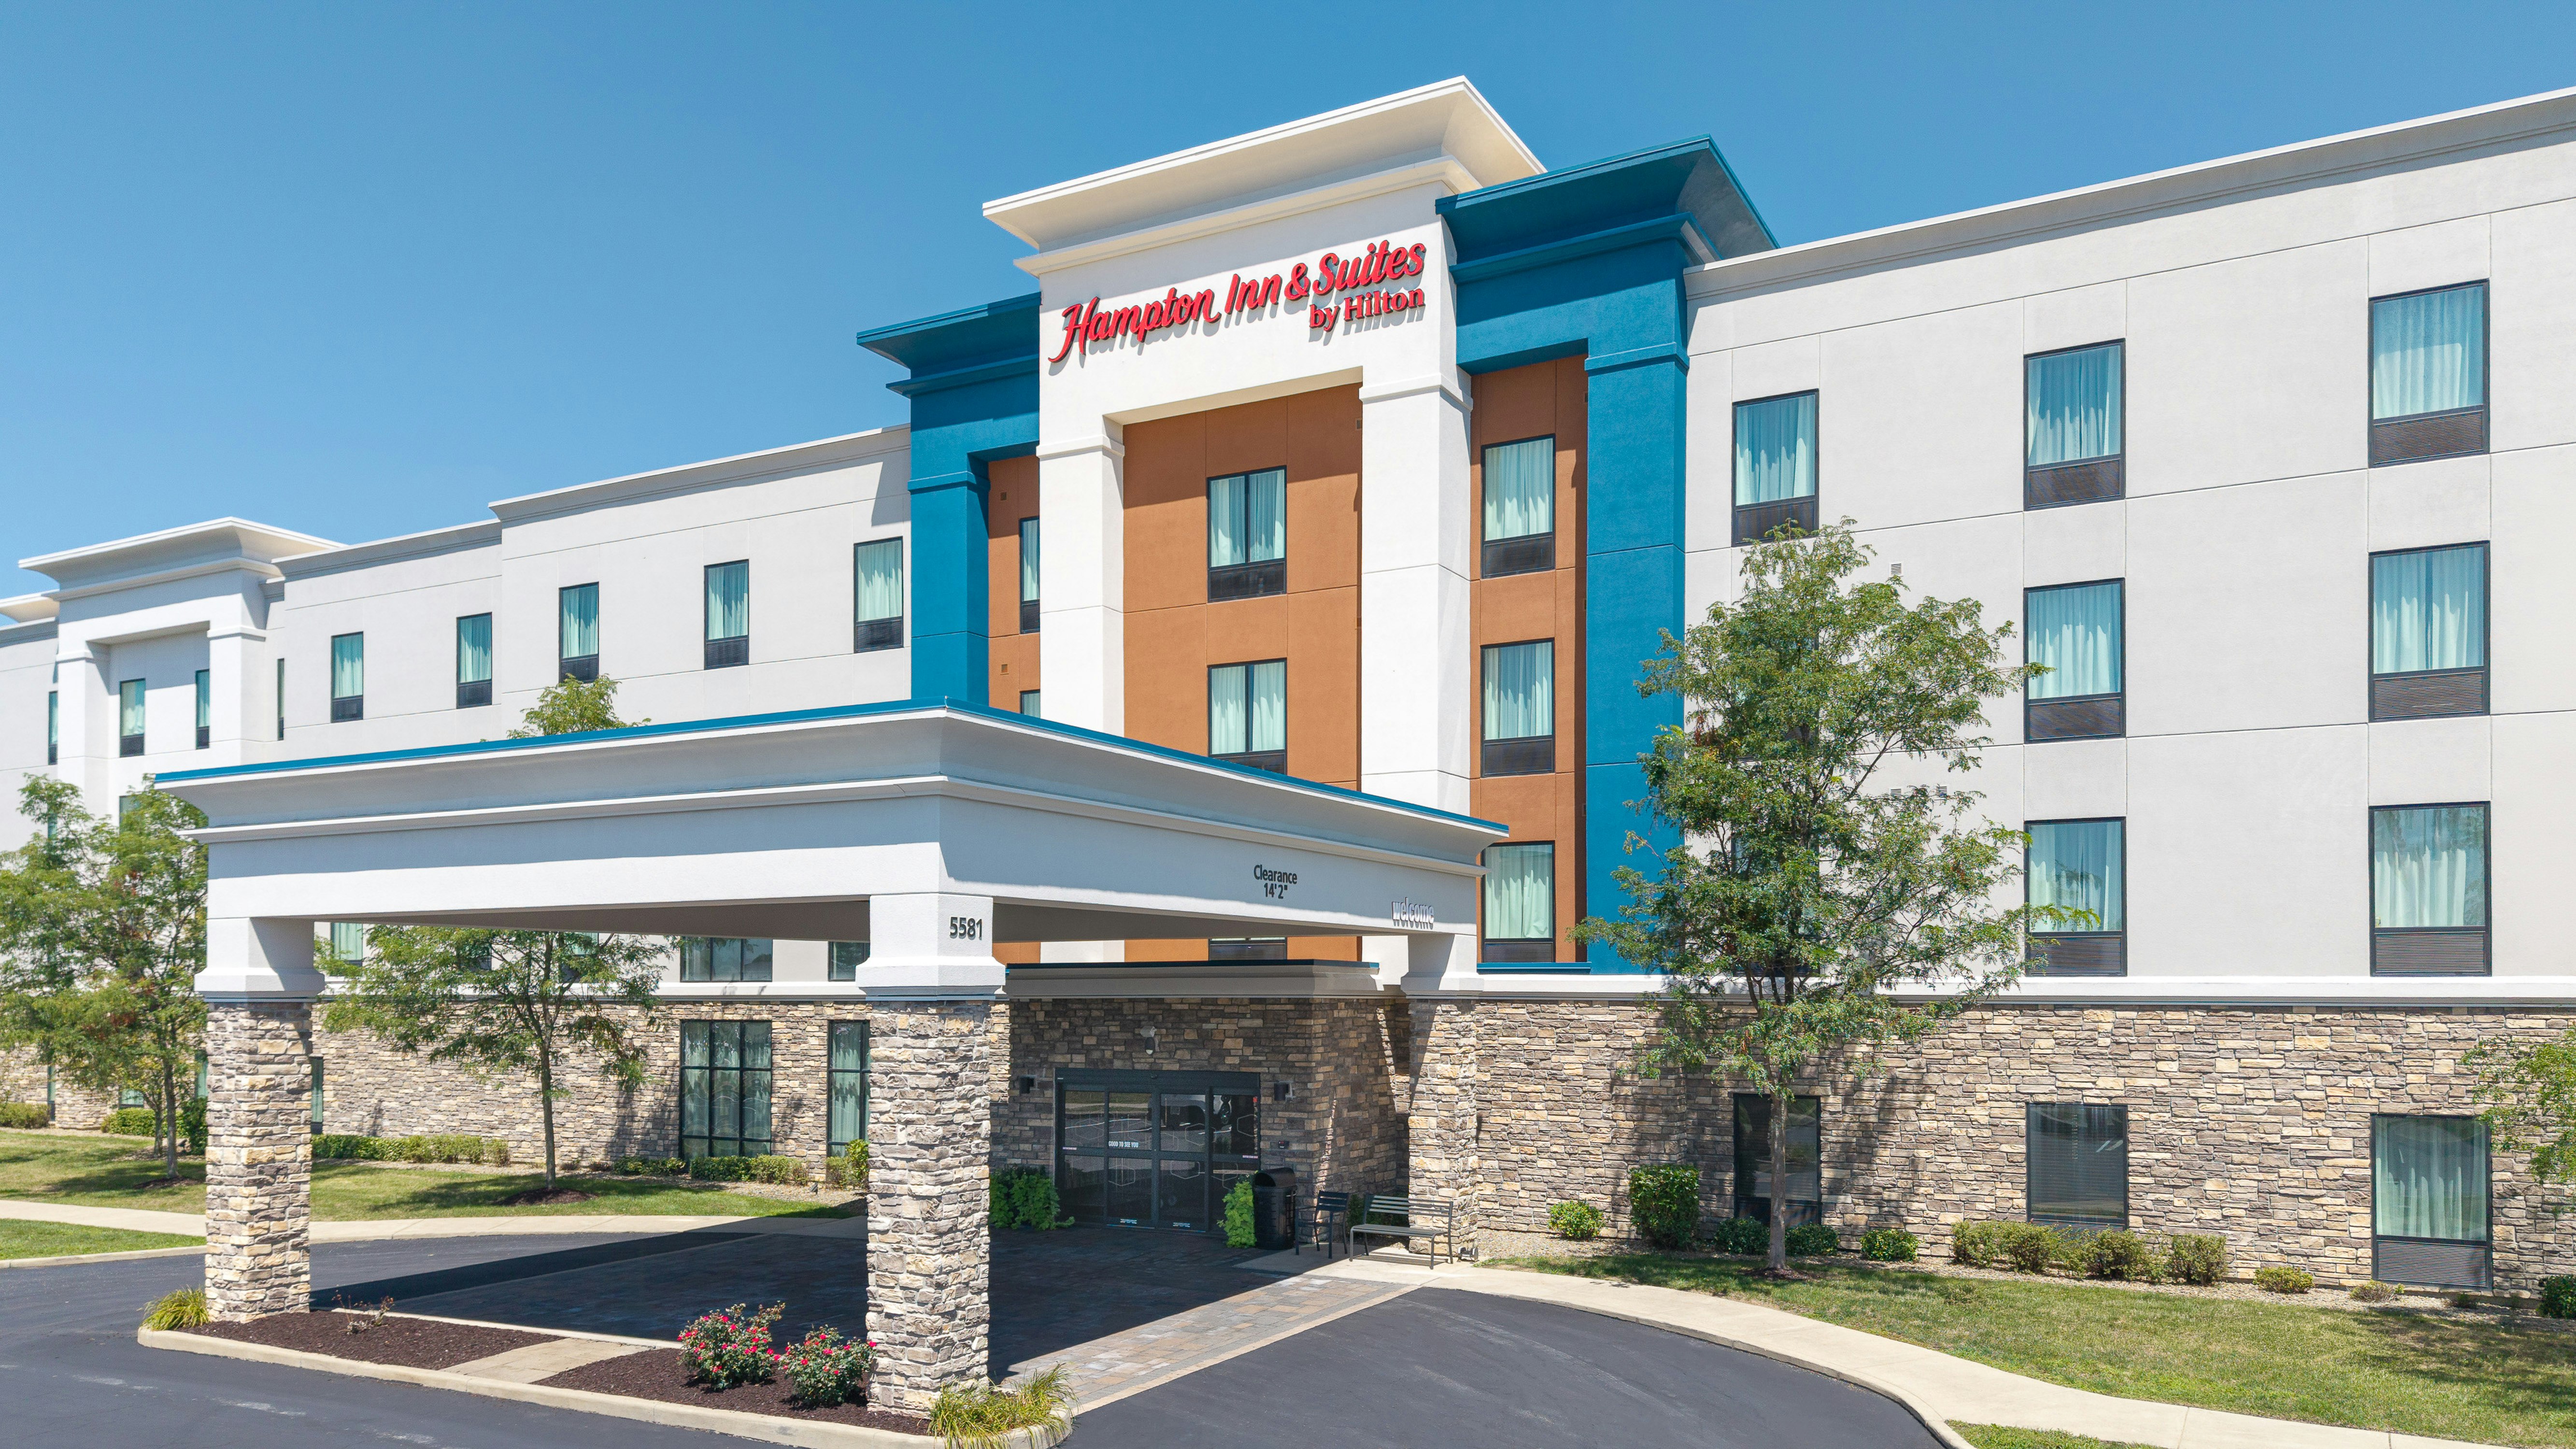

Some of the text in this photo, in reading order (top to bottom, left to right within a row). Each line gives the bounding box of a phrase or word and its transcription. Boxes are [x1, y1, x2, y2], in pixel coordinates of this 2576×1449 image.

[1048, 288, 1222, 363] Hampton
[1224, 274, 1283, 315] Inn
[1312, 240, 1426, 296] Suites
[1309, 287, 1425, 332] by Hilton
[1253, 864, 1297, 884] Clearance
[1391, 896, 1435, 924] welcome
[950, 917, 982, 938] 5581
